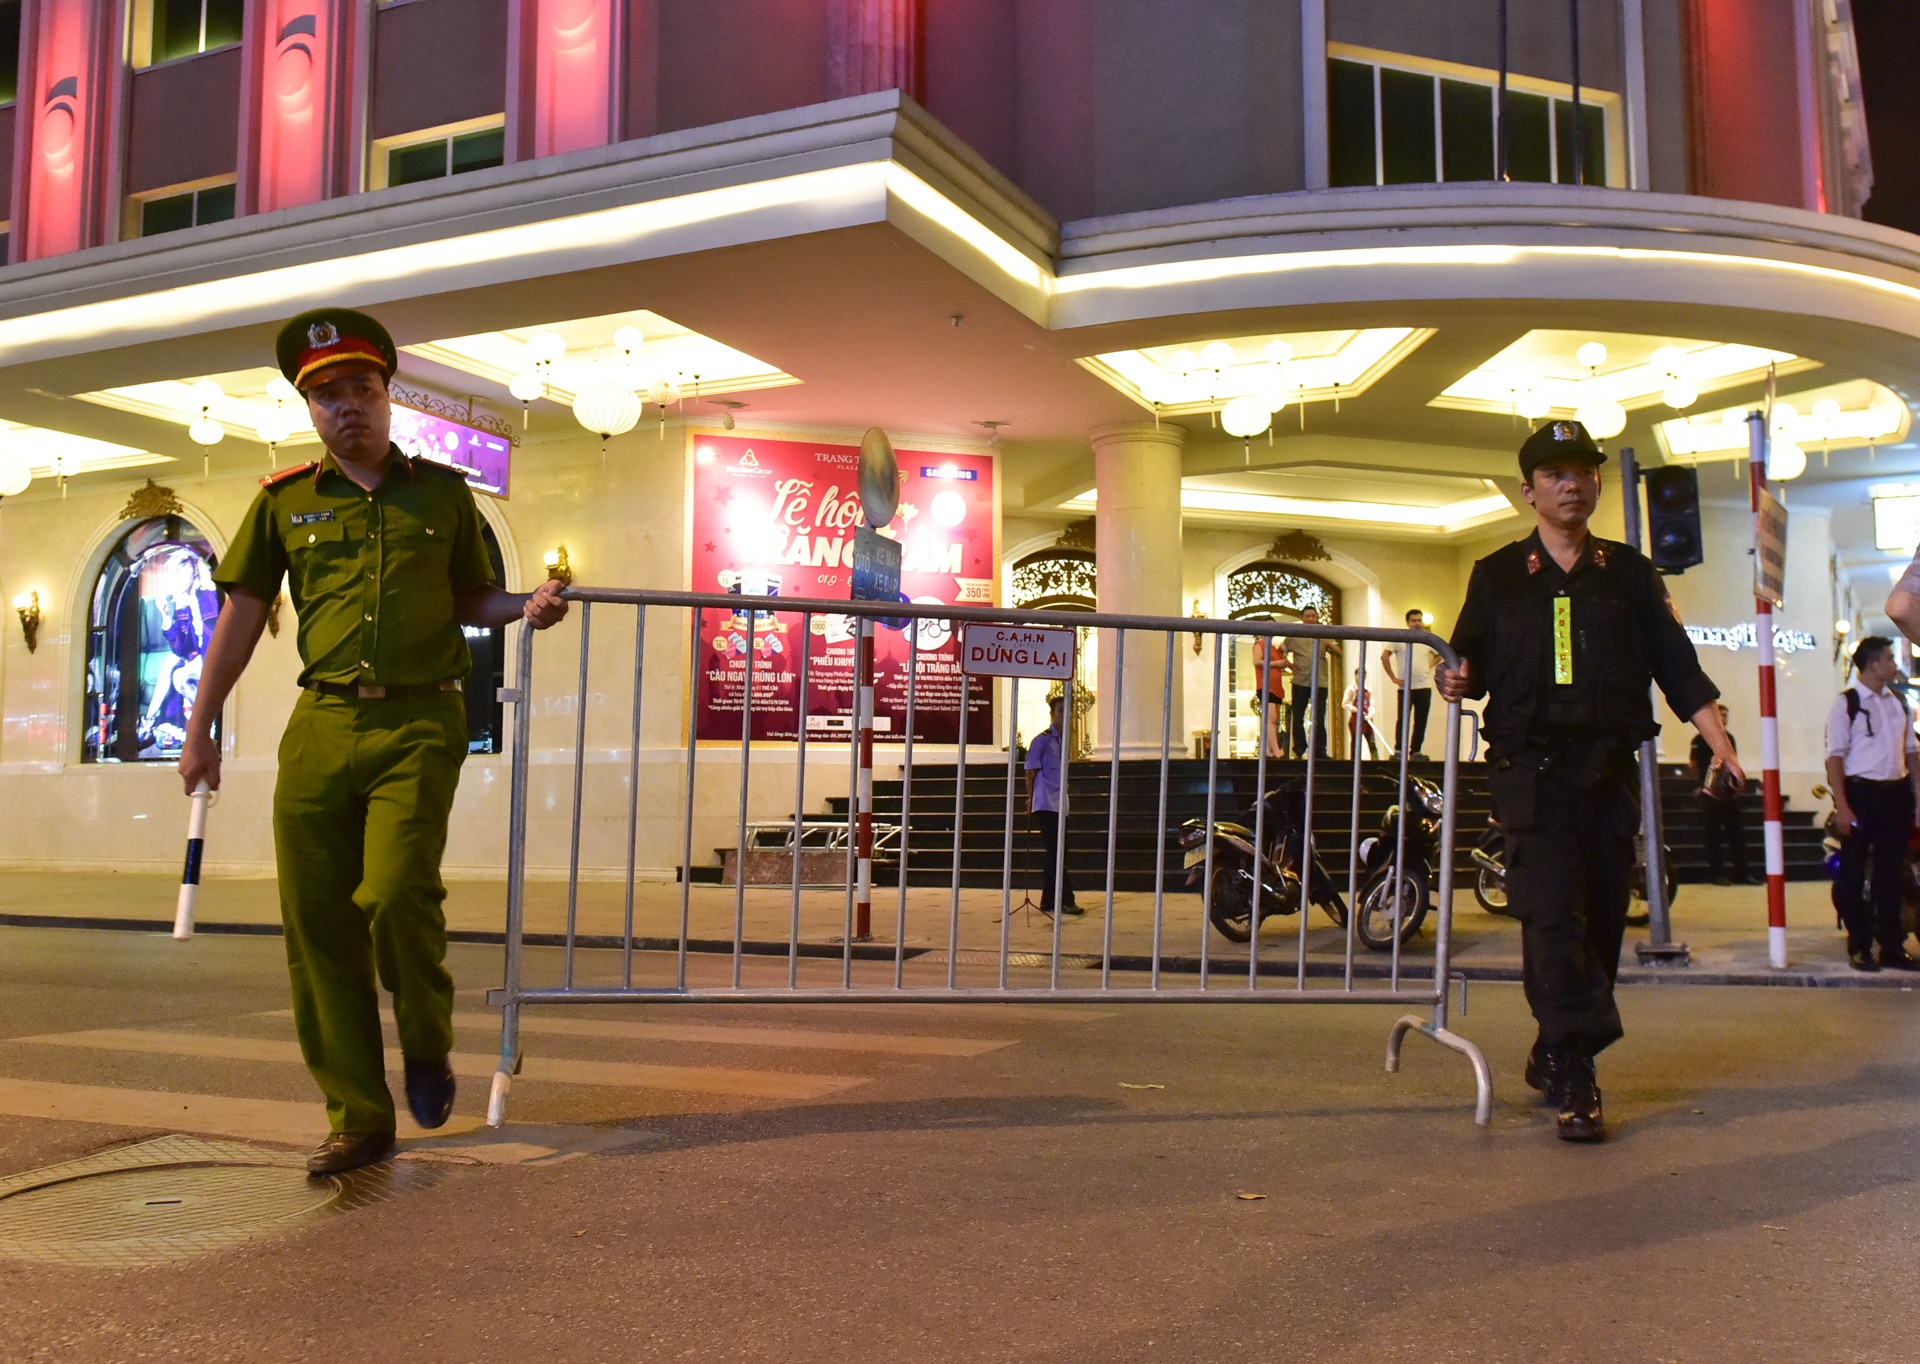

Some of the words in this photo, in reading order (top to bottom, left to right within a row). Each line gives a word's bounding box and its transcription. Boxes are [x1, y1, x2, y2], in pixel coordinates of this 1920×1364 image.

[815, 453, 853, 463] TRANG
[925, 468, 972, 480] SAUNG
[966, 587, 982, 598] 350
[996, 631, 1045, 643] C.A.H.N
[971, 643, 1029, 665] DỪNG
[1033, 650, 1067, 670] LẠI
